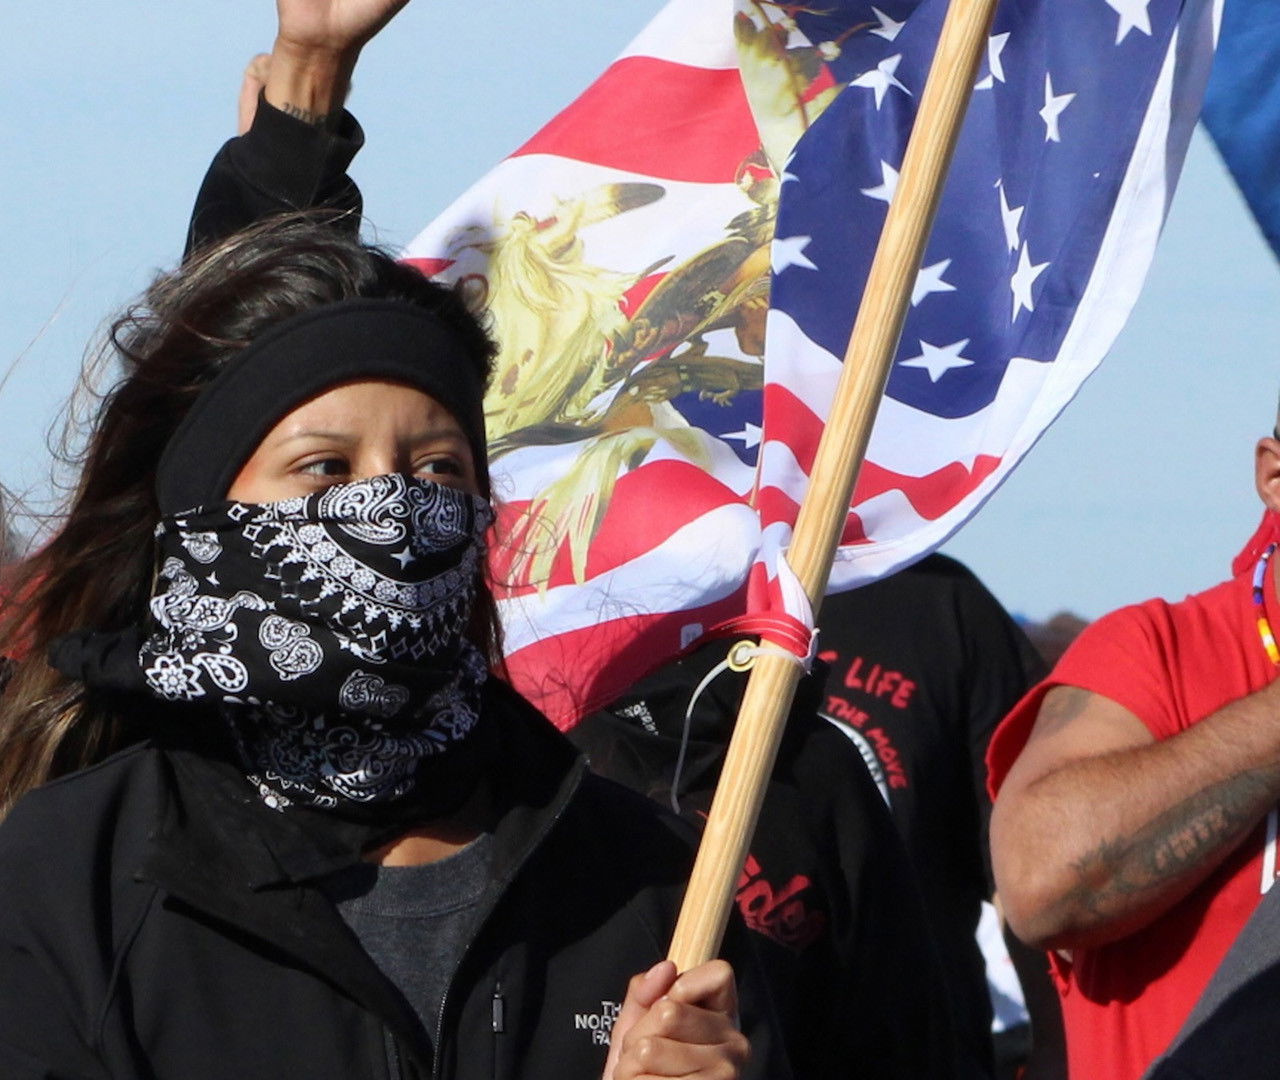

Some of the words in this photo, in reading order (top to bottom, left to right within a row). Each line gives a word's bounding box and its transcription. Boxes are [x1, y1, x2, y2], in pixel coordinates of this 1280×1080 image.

[844, 655, 917, 709] LIFE
[826, 695, 870, 729] THE
[601, 1000, 622, 1016] TH
[575, 1013, 618, 1030] NOR
[592, 1030, 611, 1046] FA
